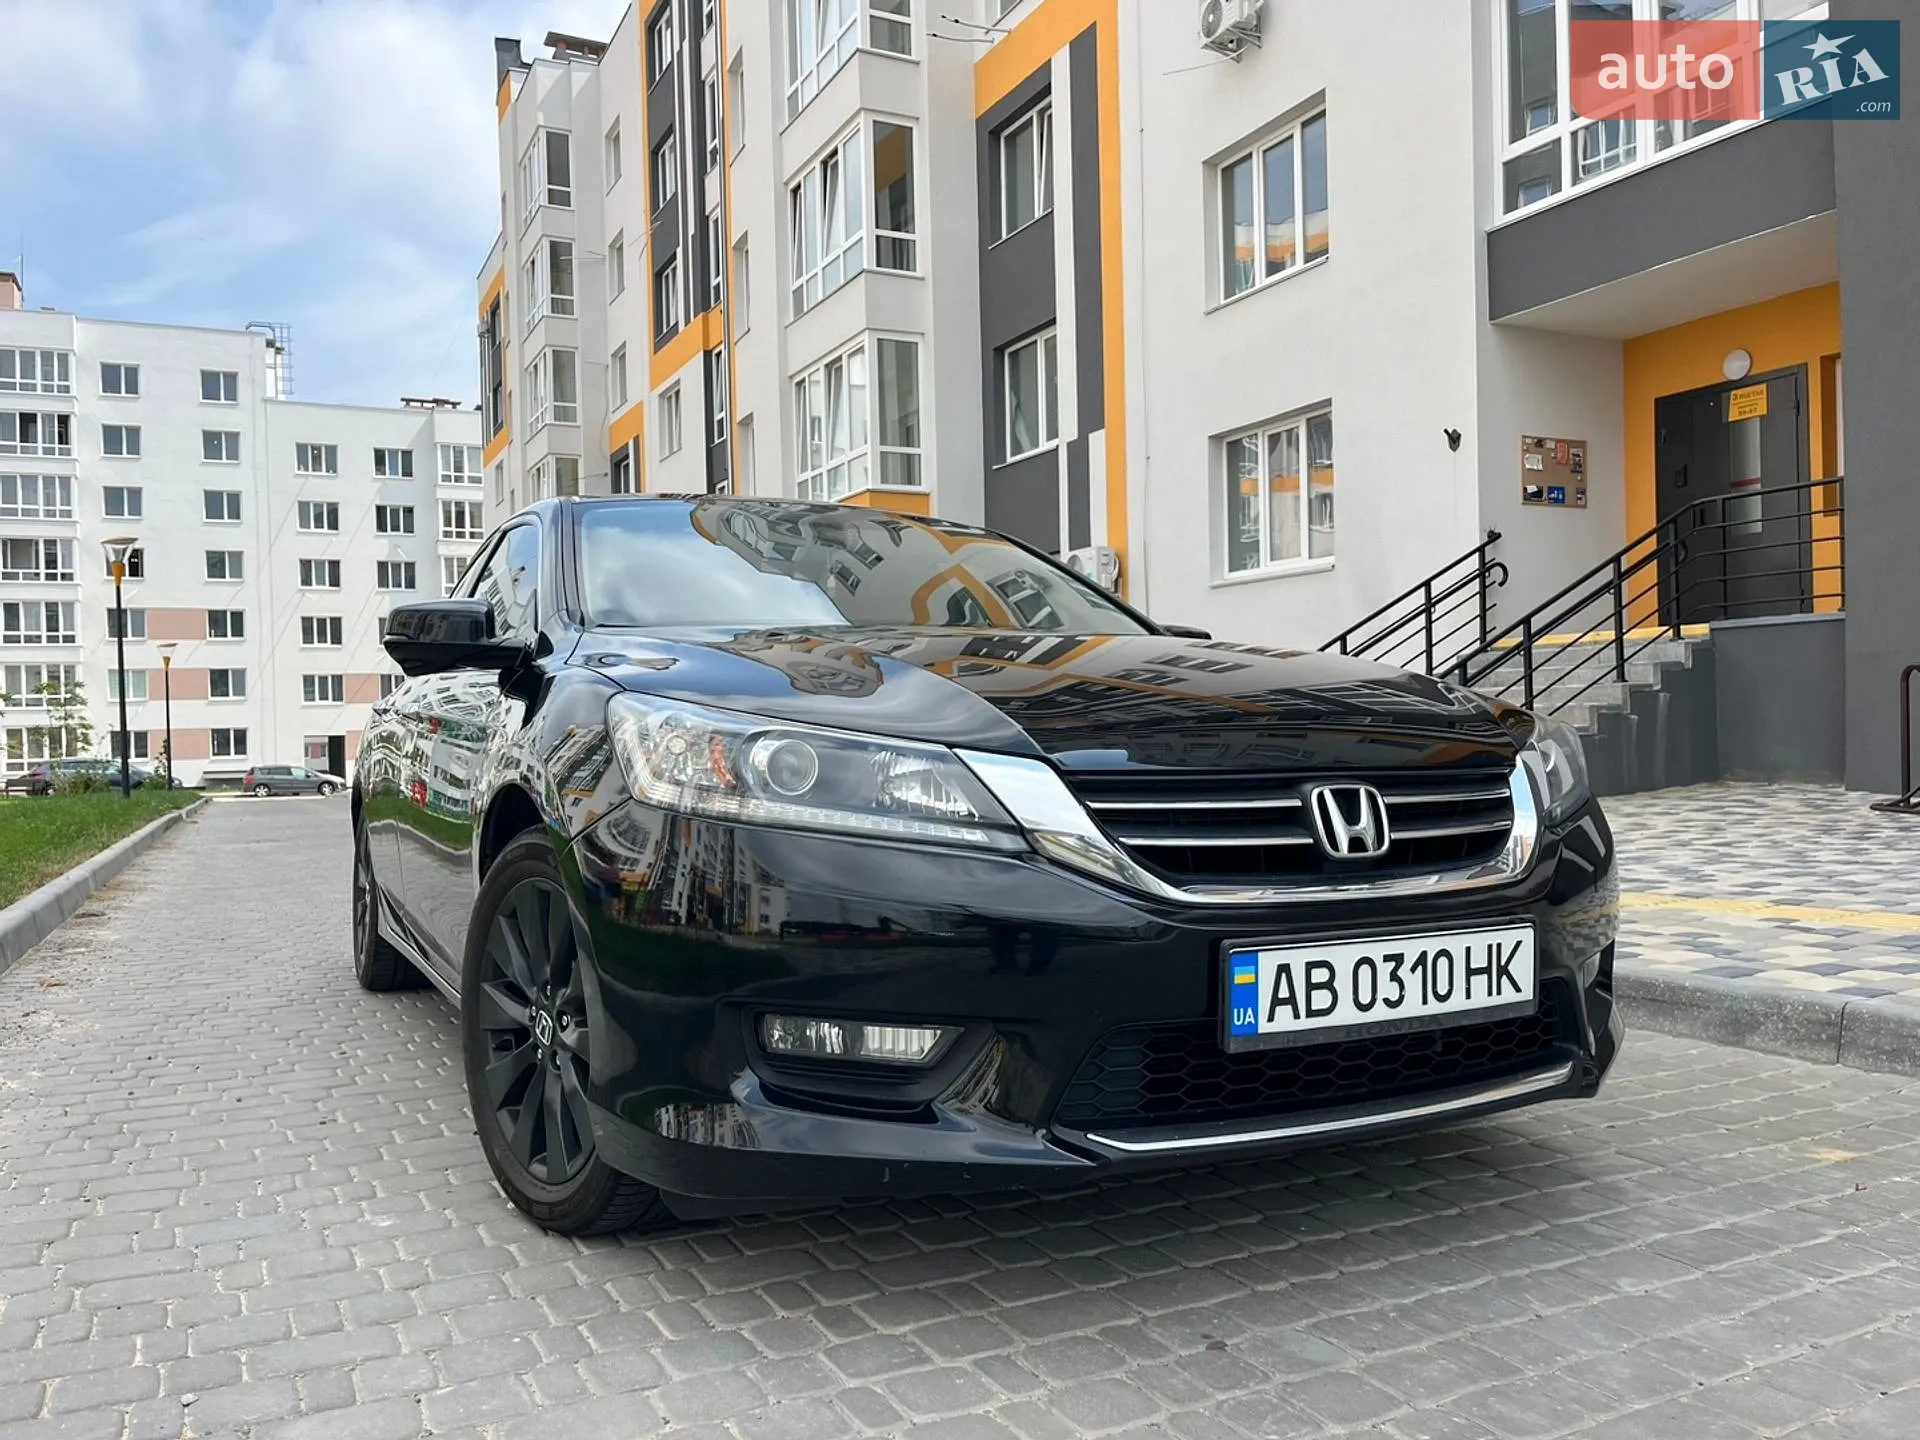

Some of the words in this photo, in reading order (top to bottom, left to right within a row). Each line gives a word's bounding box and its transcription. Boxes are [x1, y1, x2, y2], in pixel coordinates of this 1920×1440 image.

[1266, 959, 1339, 1023] AB
[1352, 948, 1454, 1012] 0310
[1464, 939, 1524, 1000] HK
[1233, 1007, 1255, 1026] UA
